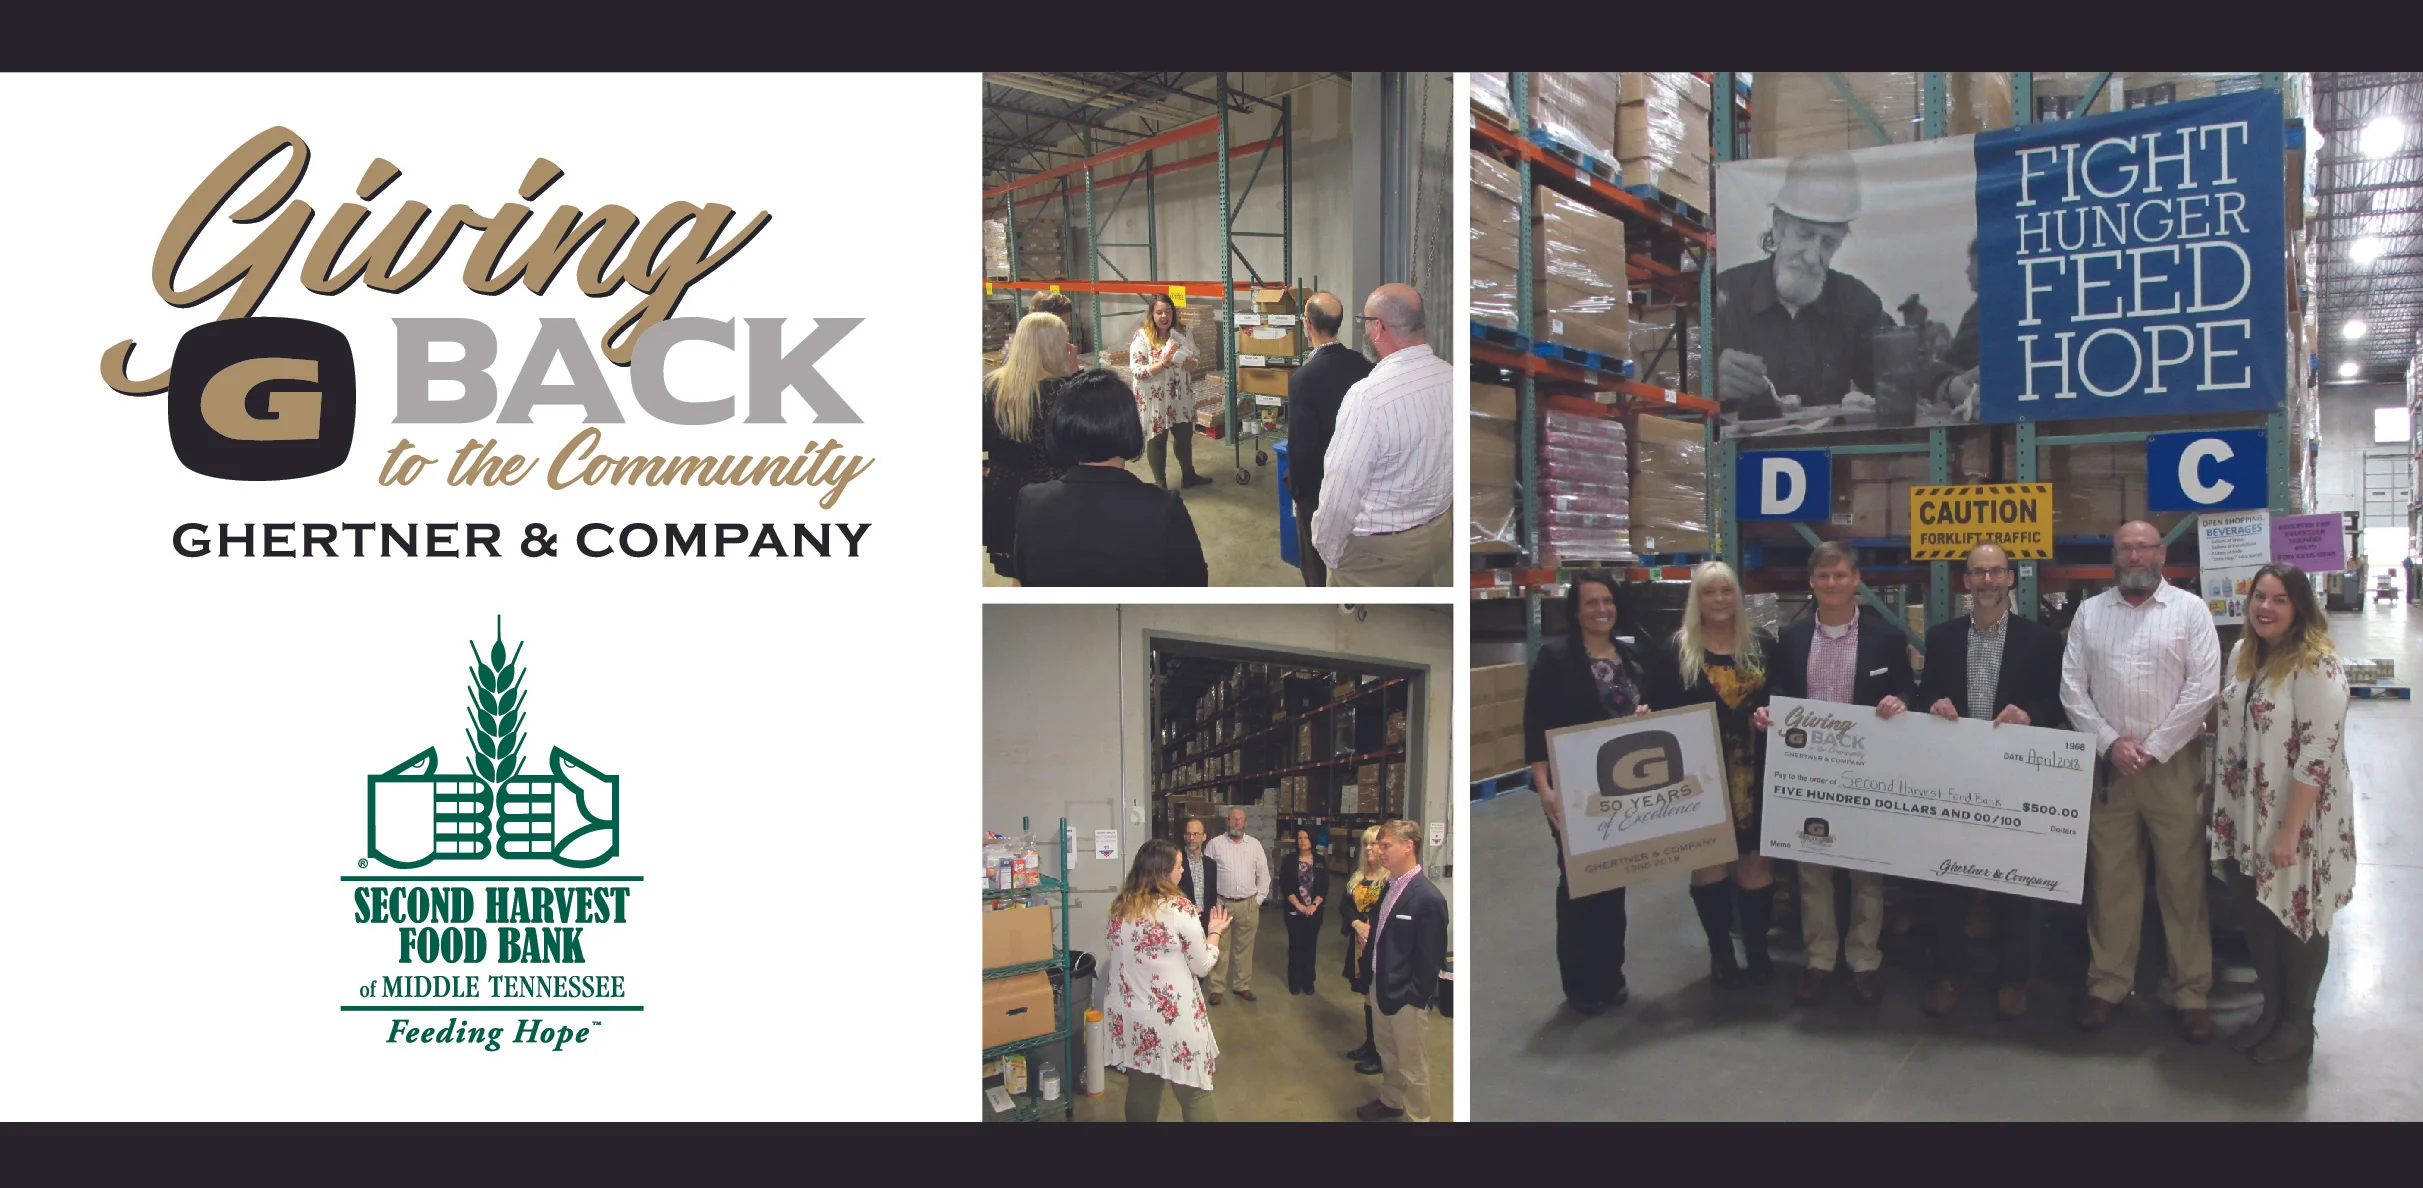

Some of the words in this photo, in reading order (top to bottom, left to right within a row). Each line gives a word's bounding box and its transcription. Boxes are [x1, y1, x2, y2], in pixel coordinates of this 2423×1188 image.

[2015, 121, 2248, 207] FIGHT
[2015, 192, 2250, 255] HUNGER
[2017, 241, 2251, 327] FEED
[2017, 319, 2251, 401] HOPE
[1761, 457, 1806, 514] D
[2178, 438, 2235, 504] C
[1919, 499, 2037, 525] CAUTION
[1921, 532, 1982, 545] FORKLIFT
[1986, 531, 2041, 544] TRAFFIC
[2206, 523, 2263, 537] BEVERAGES
[1778, 705, 1857, 741] Giving
[1811, 730, 1866, 750] BACK
[2065, 742, 2086, 751] 1968
[1612, 747, 1670, 790] G
[2004, 752, 2024, 762] DATE
[1774, 771, 1786, 781] Pay
[1788, 772, 1796, 780] to
[1797, 773, 1807, 782] the
[1809, 776, 1827, 785] order
[1841, 771, 1894, 792] Second
[1900, 780, 1942, 799] Harvest
[1600, 799, 1623, 812] 50
[1630, 785, 1692, 809] YEARS
[1774, 786, 1803, 797] FIVE
[1807, 789, 1871, 807] HUNDRED
[1875, 799, 1937, 816] DOLLARS
[1941, 808, 1971, 820] AND
[2022, 802, 2079, 819] $500.00
[1597, 810, 1617, 840] of
[1618, 801, 1702, 832] Excellence
[2050, 825, 2077, 836] Dollars
[1585, 851, 1649, 874] GHERTNER
[1663, 837, 1717, 856] COMPANY
[1770, 840, 1792, 849] Memo
[1936, 859, 1991, 876] Ghertner
[2005, 868, 2061, 891] Company
